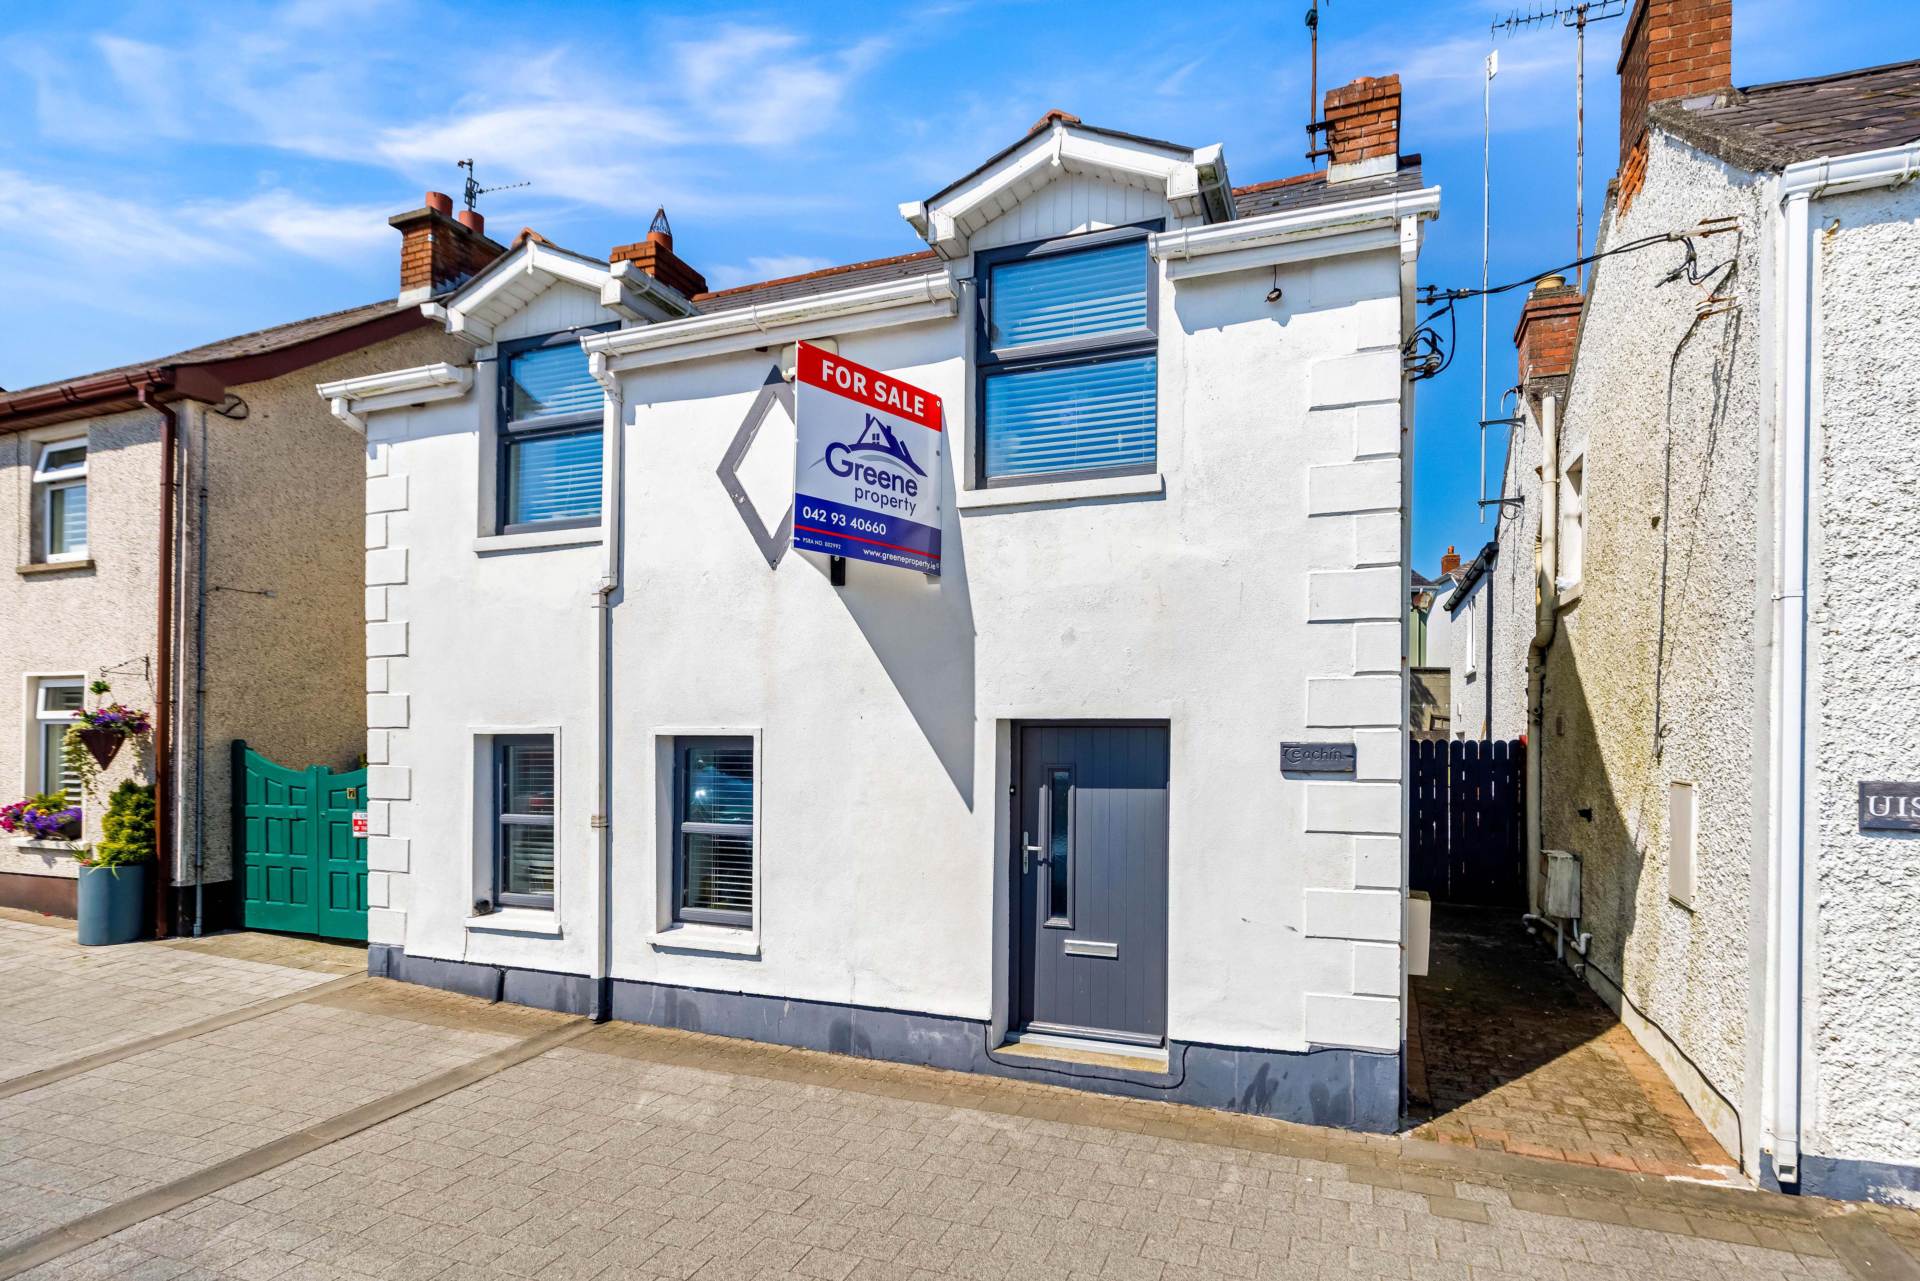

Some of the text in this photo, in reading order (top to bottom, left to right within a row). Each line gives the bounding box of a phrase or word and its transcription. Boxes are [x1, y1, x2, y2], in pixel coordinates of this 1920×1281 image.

[822, 359, 925, 417] FOR SALE
[825, 442, 918, 497] Greene
[855, 487, 917, 517] property
[802, 506, 887, 535] 042 93 40660
[863, 548, 936, 570] www.greeneproperty.ie
